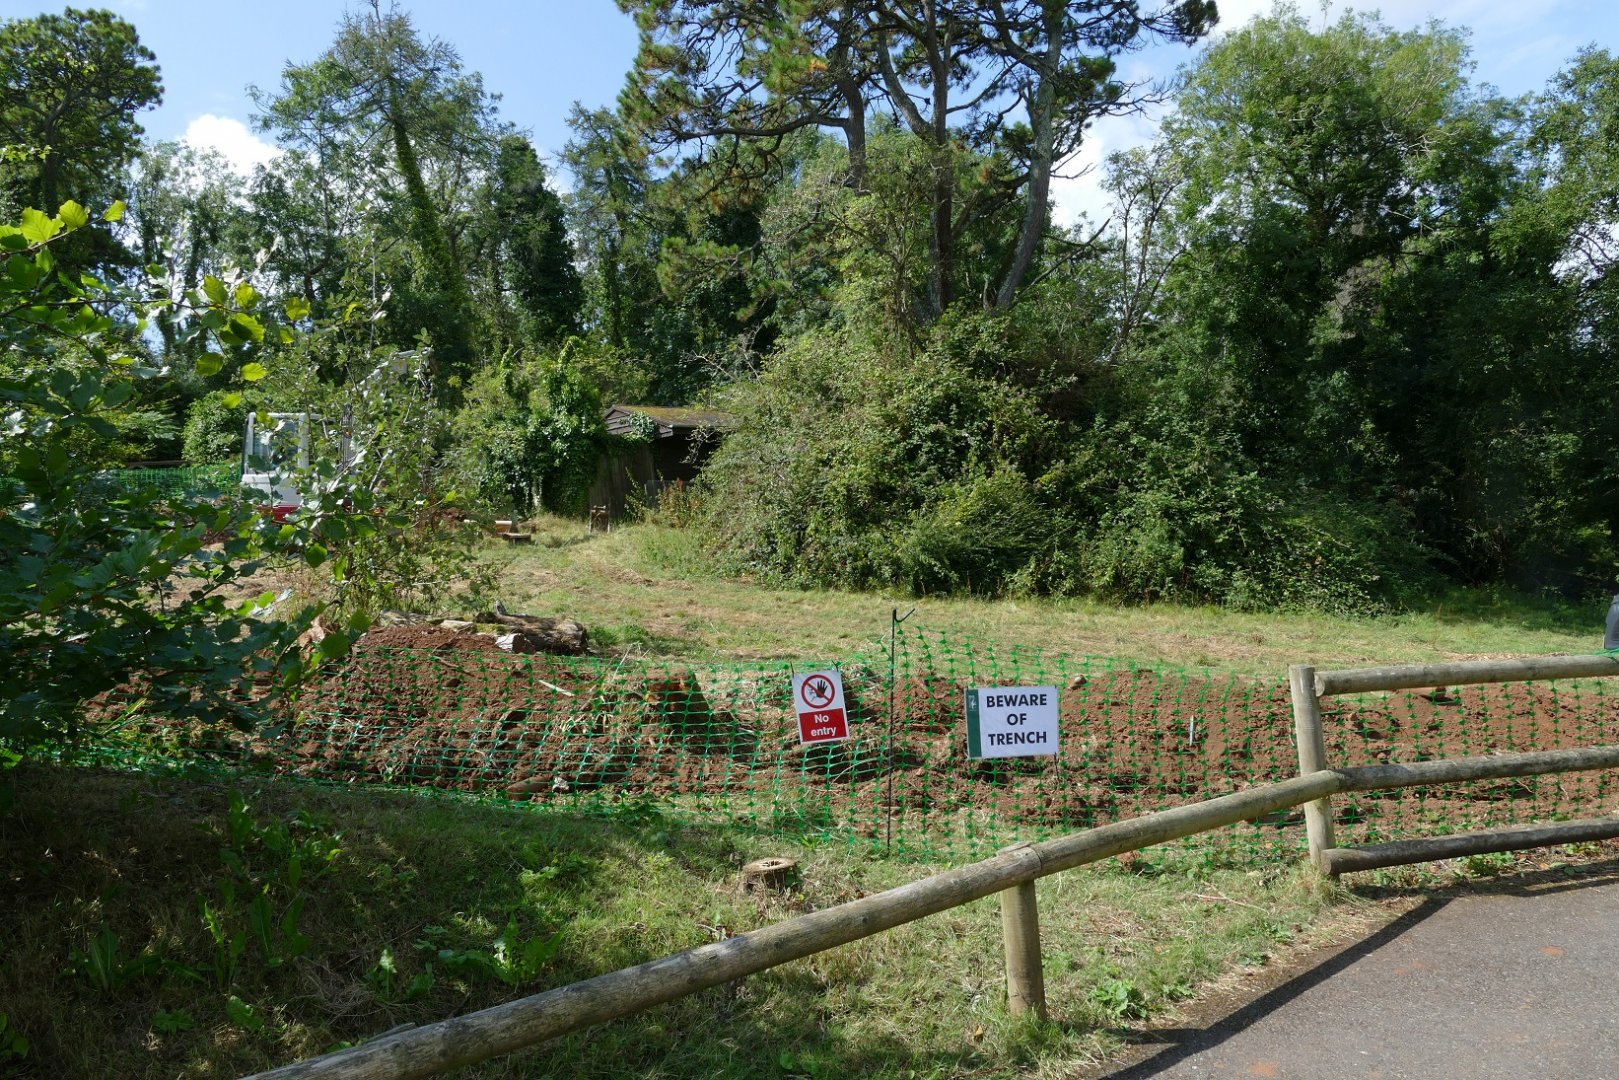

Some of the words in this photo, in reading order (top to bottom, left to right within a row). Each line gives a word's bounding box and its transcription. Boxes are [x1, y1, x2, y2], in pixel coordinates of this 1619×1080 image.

[986, 693, 1047, 708] BEWARE
[814, 714, 829, 724] No
[1006, 713, 1027, 726] OF
[810, 726, 837, 737] entry
[987, 731, 1047, 746] TRENCH
